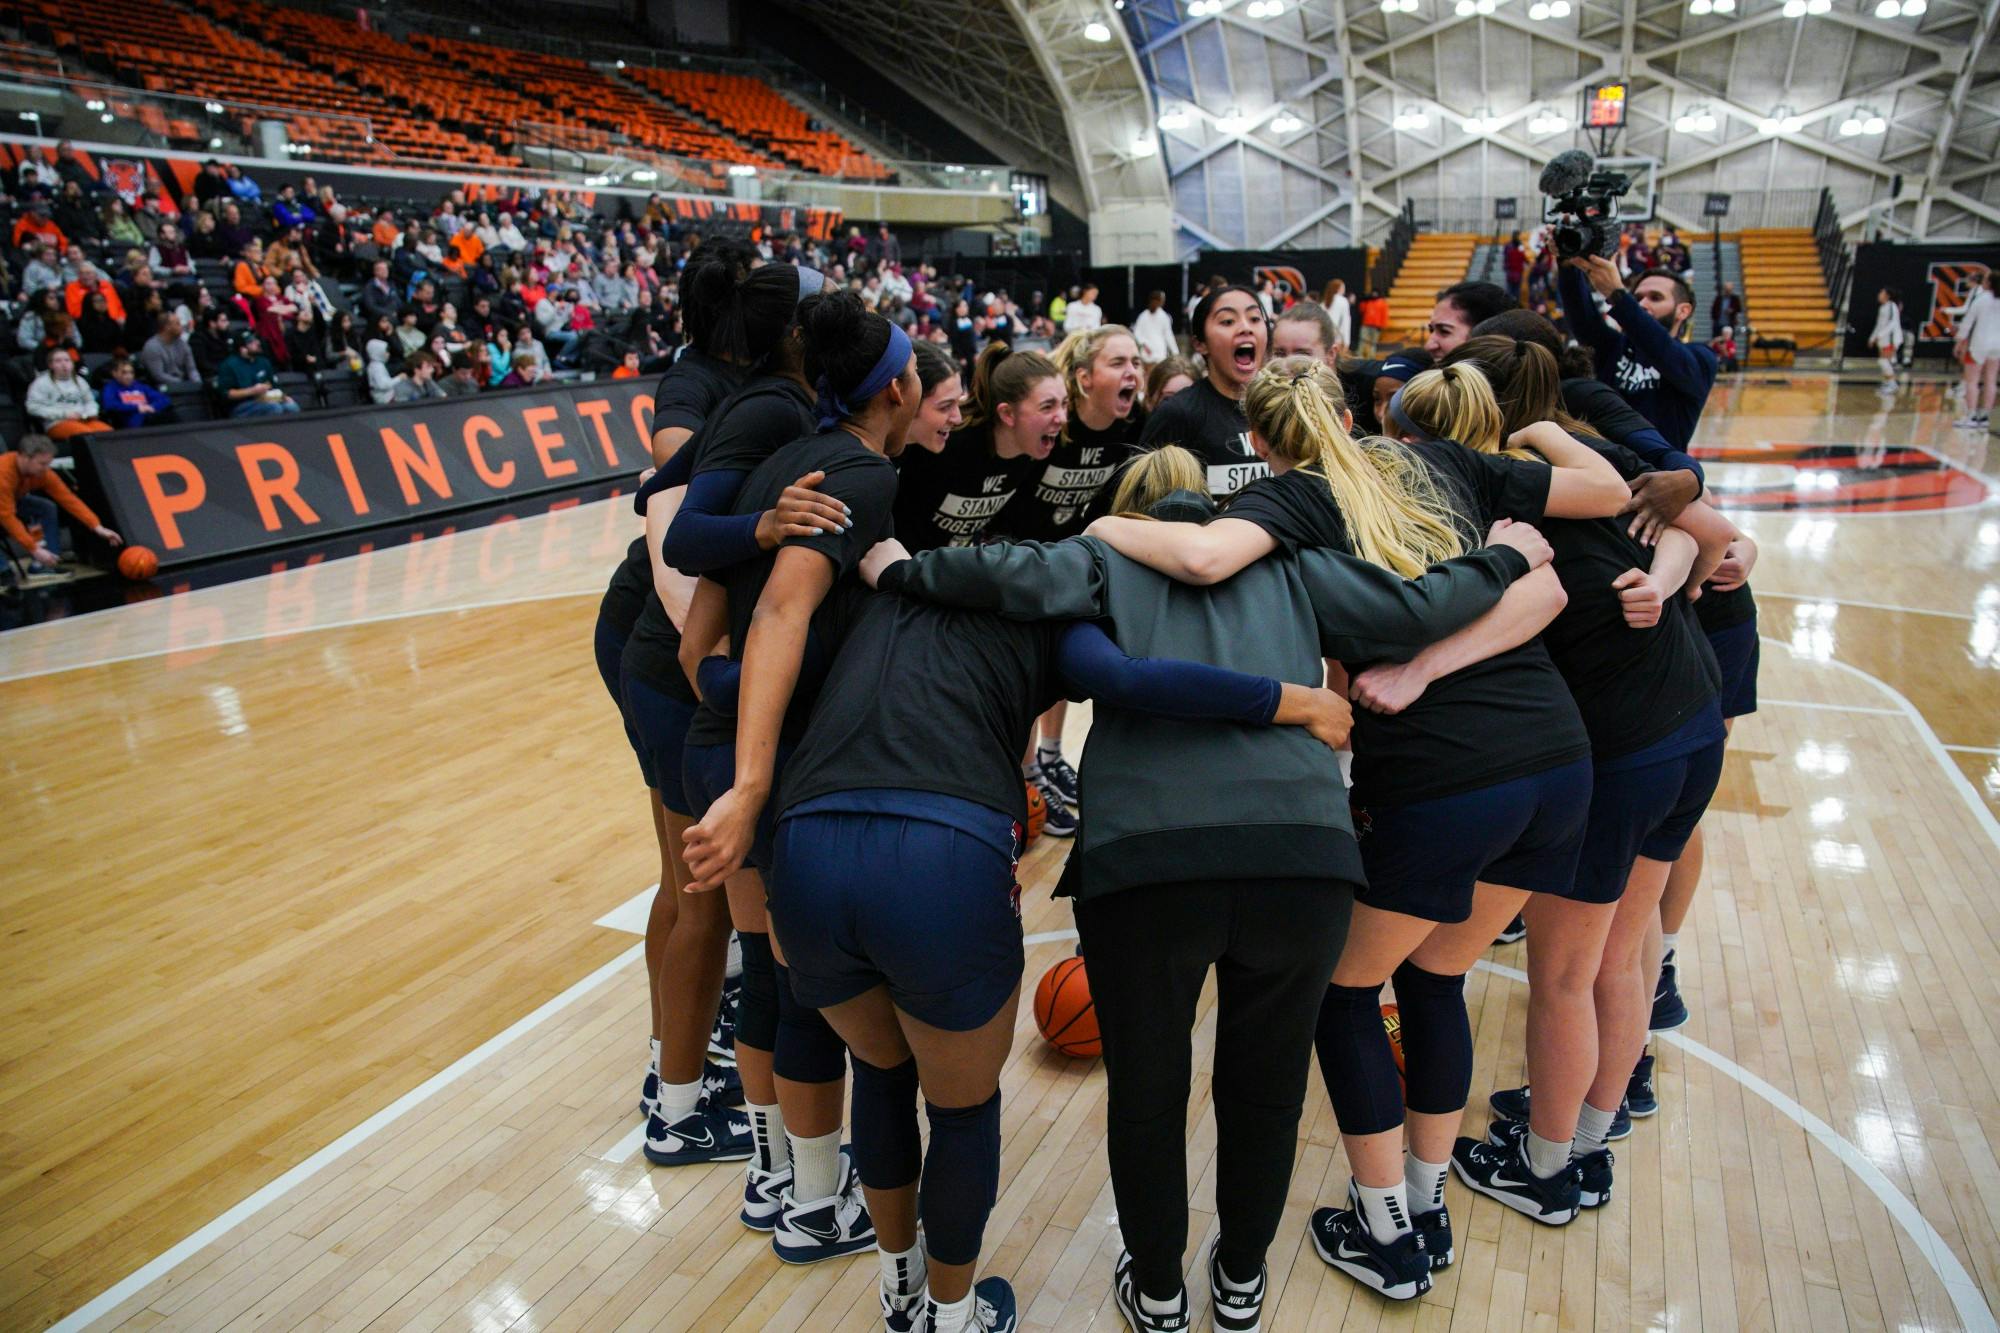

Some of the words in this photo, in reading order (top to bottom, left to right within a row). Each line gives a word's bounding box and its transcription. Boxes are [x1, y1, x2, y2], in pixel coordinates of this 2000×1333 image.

[1080, 446, 1104, 466] WE
[982, 474, 1008, 493] WE
[1059, 469, 1107, 487] STAND
[1227, 1295, 1247, 1306] NIKE
[1161, 1317, 1181, 1329] NIKE
